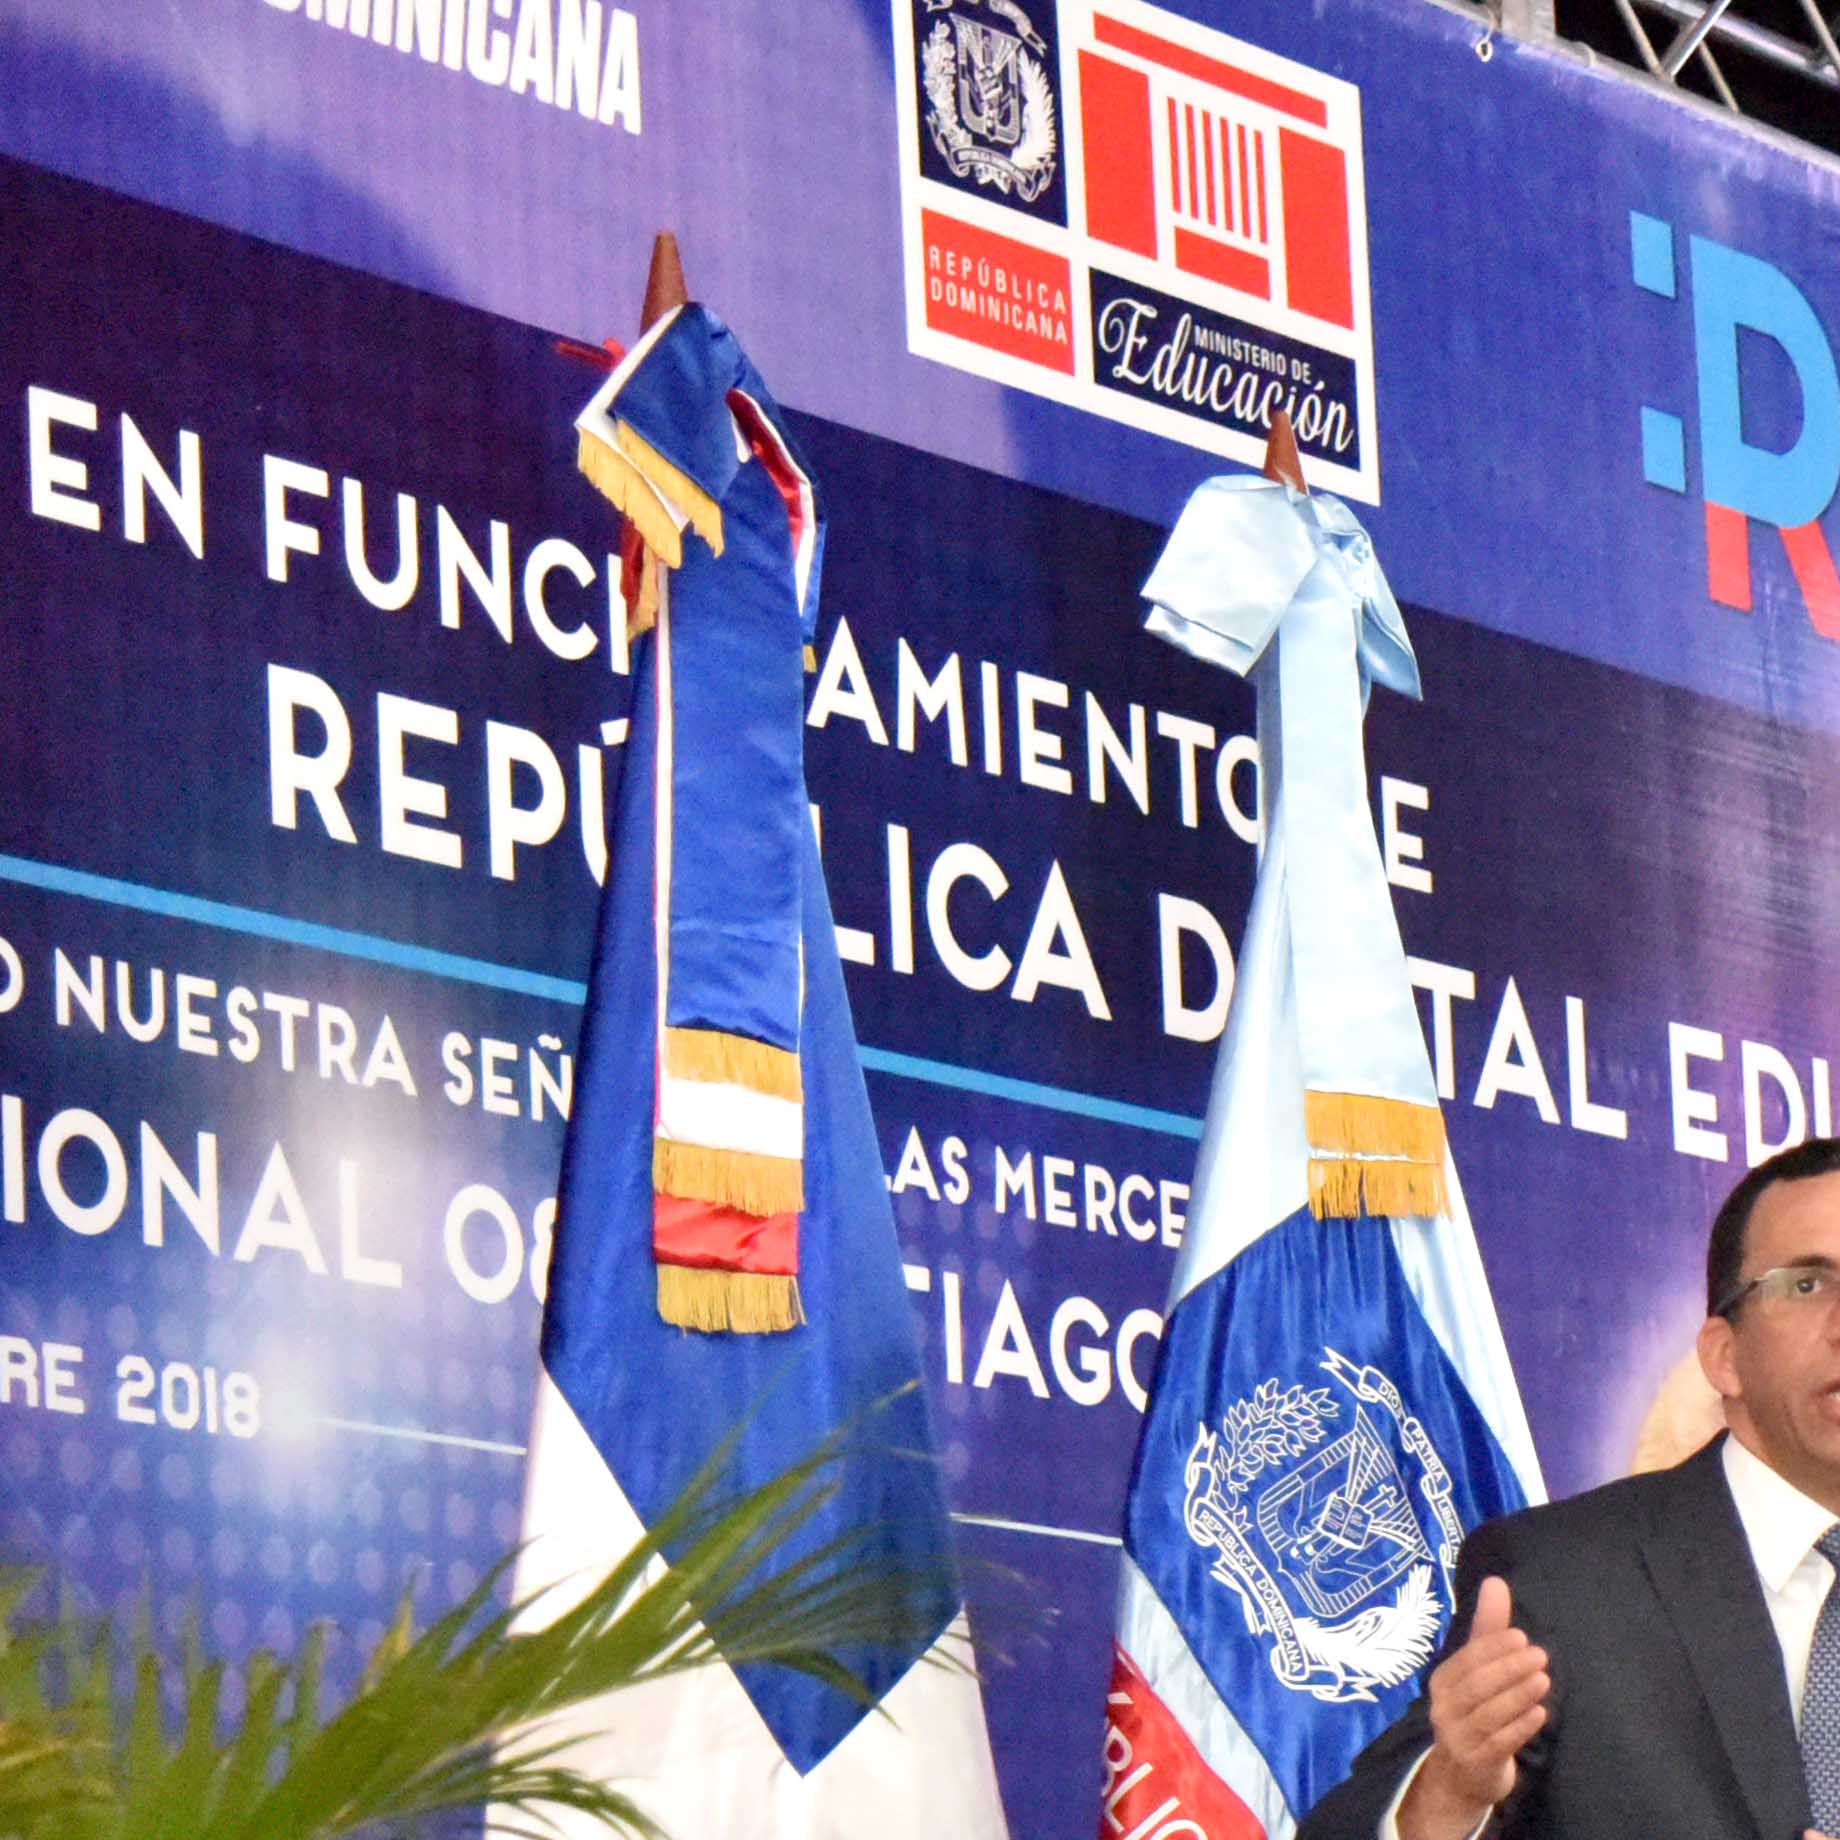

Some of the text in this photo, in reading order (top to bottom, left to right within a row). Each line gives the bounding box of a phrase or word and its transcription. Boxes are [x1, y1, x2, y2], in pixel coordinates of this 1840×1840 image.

[929, 245, 1066, 315] REPÚBLICA
[930, 276, 1067, 345] DOMINICANA
[1098, 298, 1355, 452] Educación
[1195, 325, 1312, 384] MINISTERIO DE
[28, 385, 204, 560] EN
[1382, 776, 1434, 893] E
[54, 946, 418, 1097] NUESTRA
[442, 1031, 574, 1122] SEÑ
[885, 1125, 970, 1204] AS
[994, 1145, 1191, 1248] MERCE
[116, 1355, 261, 1438] 2018
[1411, 1427, 1444, 1483] PATRIA
[1255, 1578, 1303, 1673] DOMINICANA
